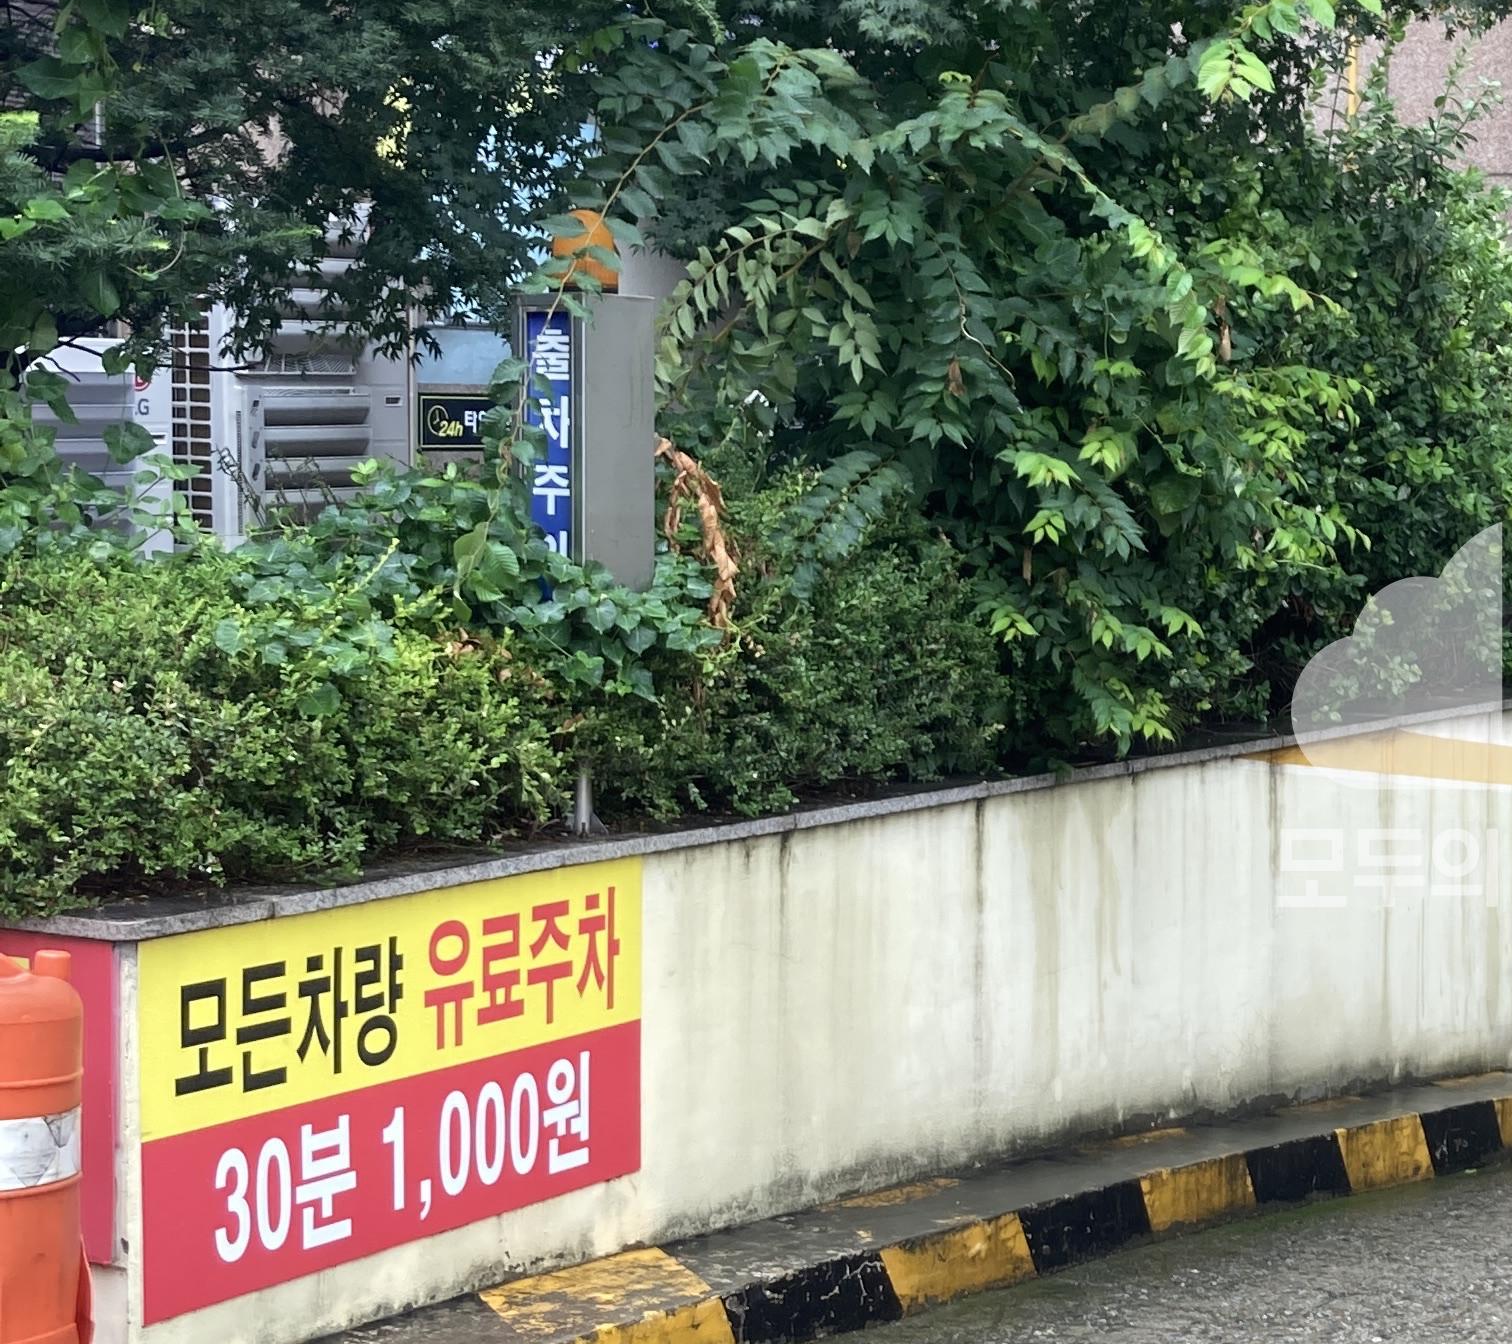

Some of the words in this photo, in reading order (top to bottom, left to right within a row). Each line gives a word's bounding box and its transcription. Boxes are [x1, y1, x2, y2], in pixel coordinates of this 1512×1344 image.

[438, 420, 464, 437] 24h
[174, 935, 405, 1097] 모든차량
[424, 886, 621, 1051] 유료주차
[213, 1113, 358, 1263] 30분
[381, 1050, 592, 1220] 1,000원
